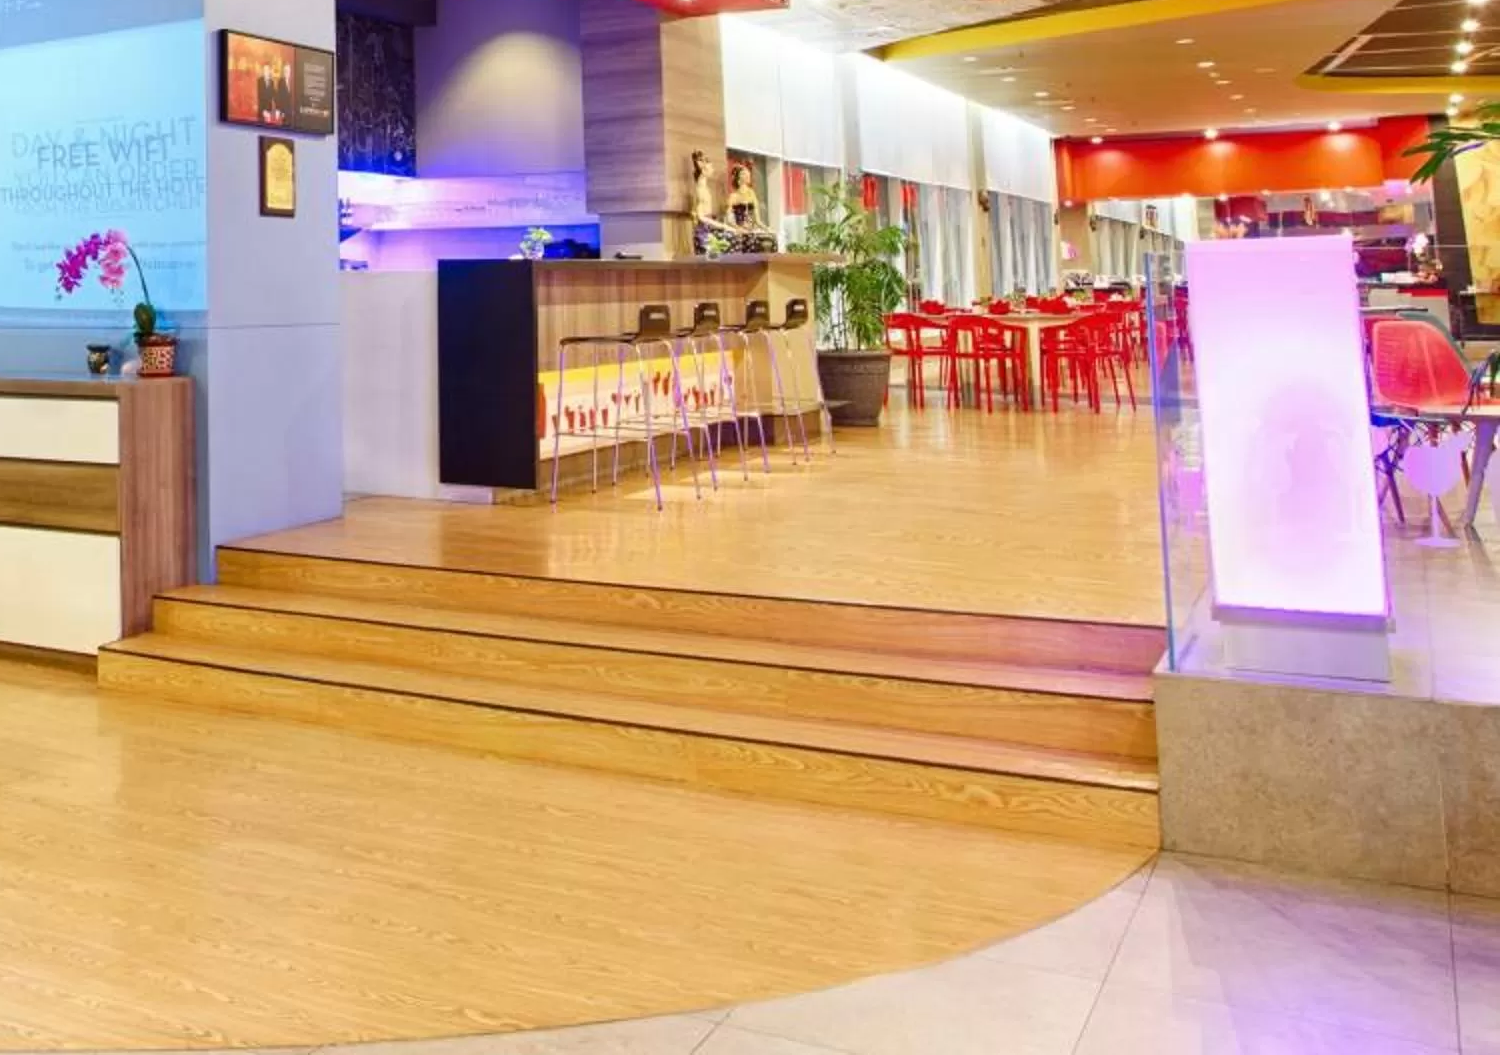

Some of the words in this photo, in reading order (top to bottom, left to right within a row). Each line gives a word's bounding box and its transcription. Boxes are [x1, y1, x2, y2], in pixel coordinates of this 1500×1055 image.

[37, 141, 101, 170] FREE
[107, 132, 169, 164] WIFI
[100, 116, 197, 151] NIGHT
[0, 182, 113, 207] THROUGHOUT
[119, 180, 151, 197] THE
